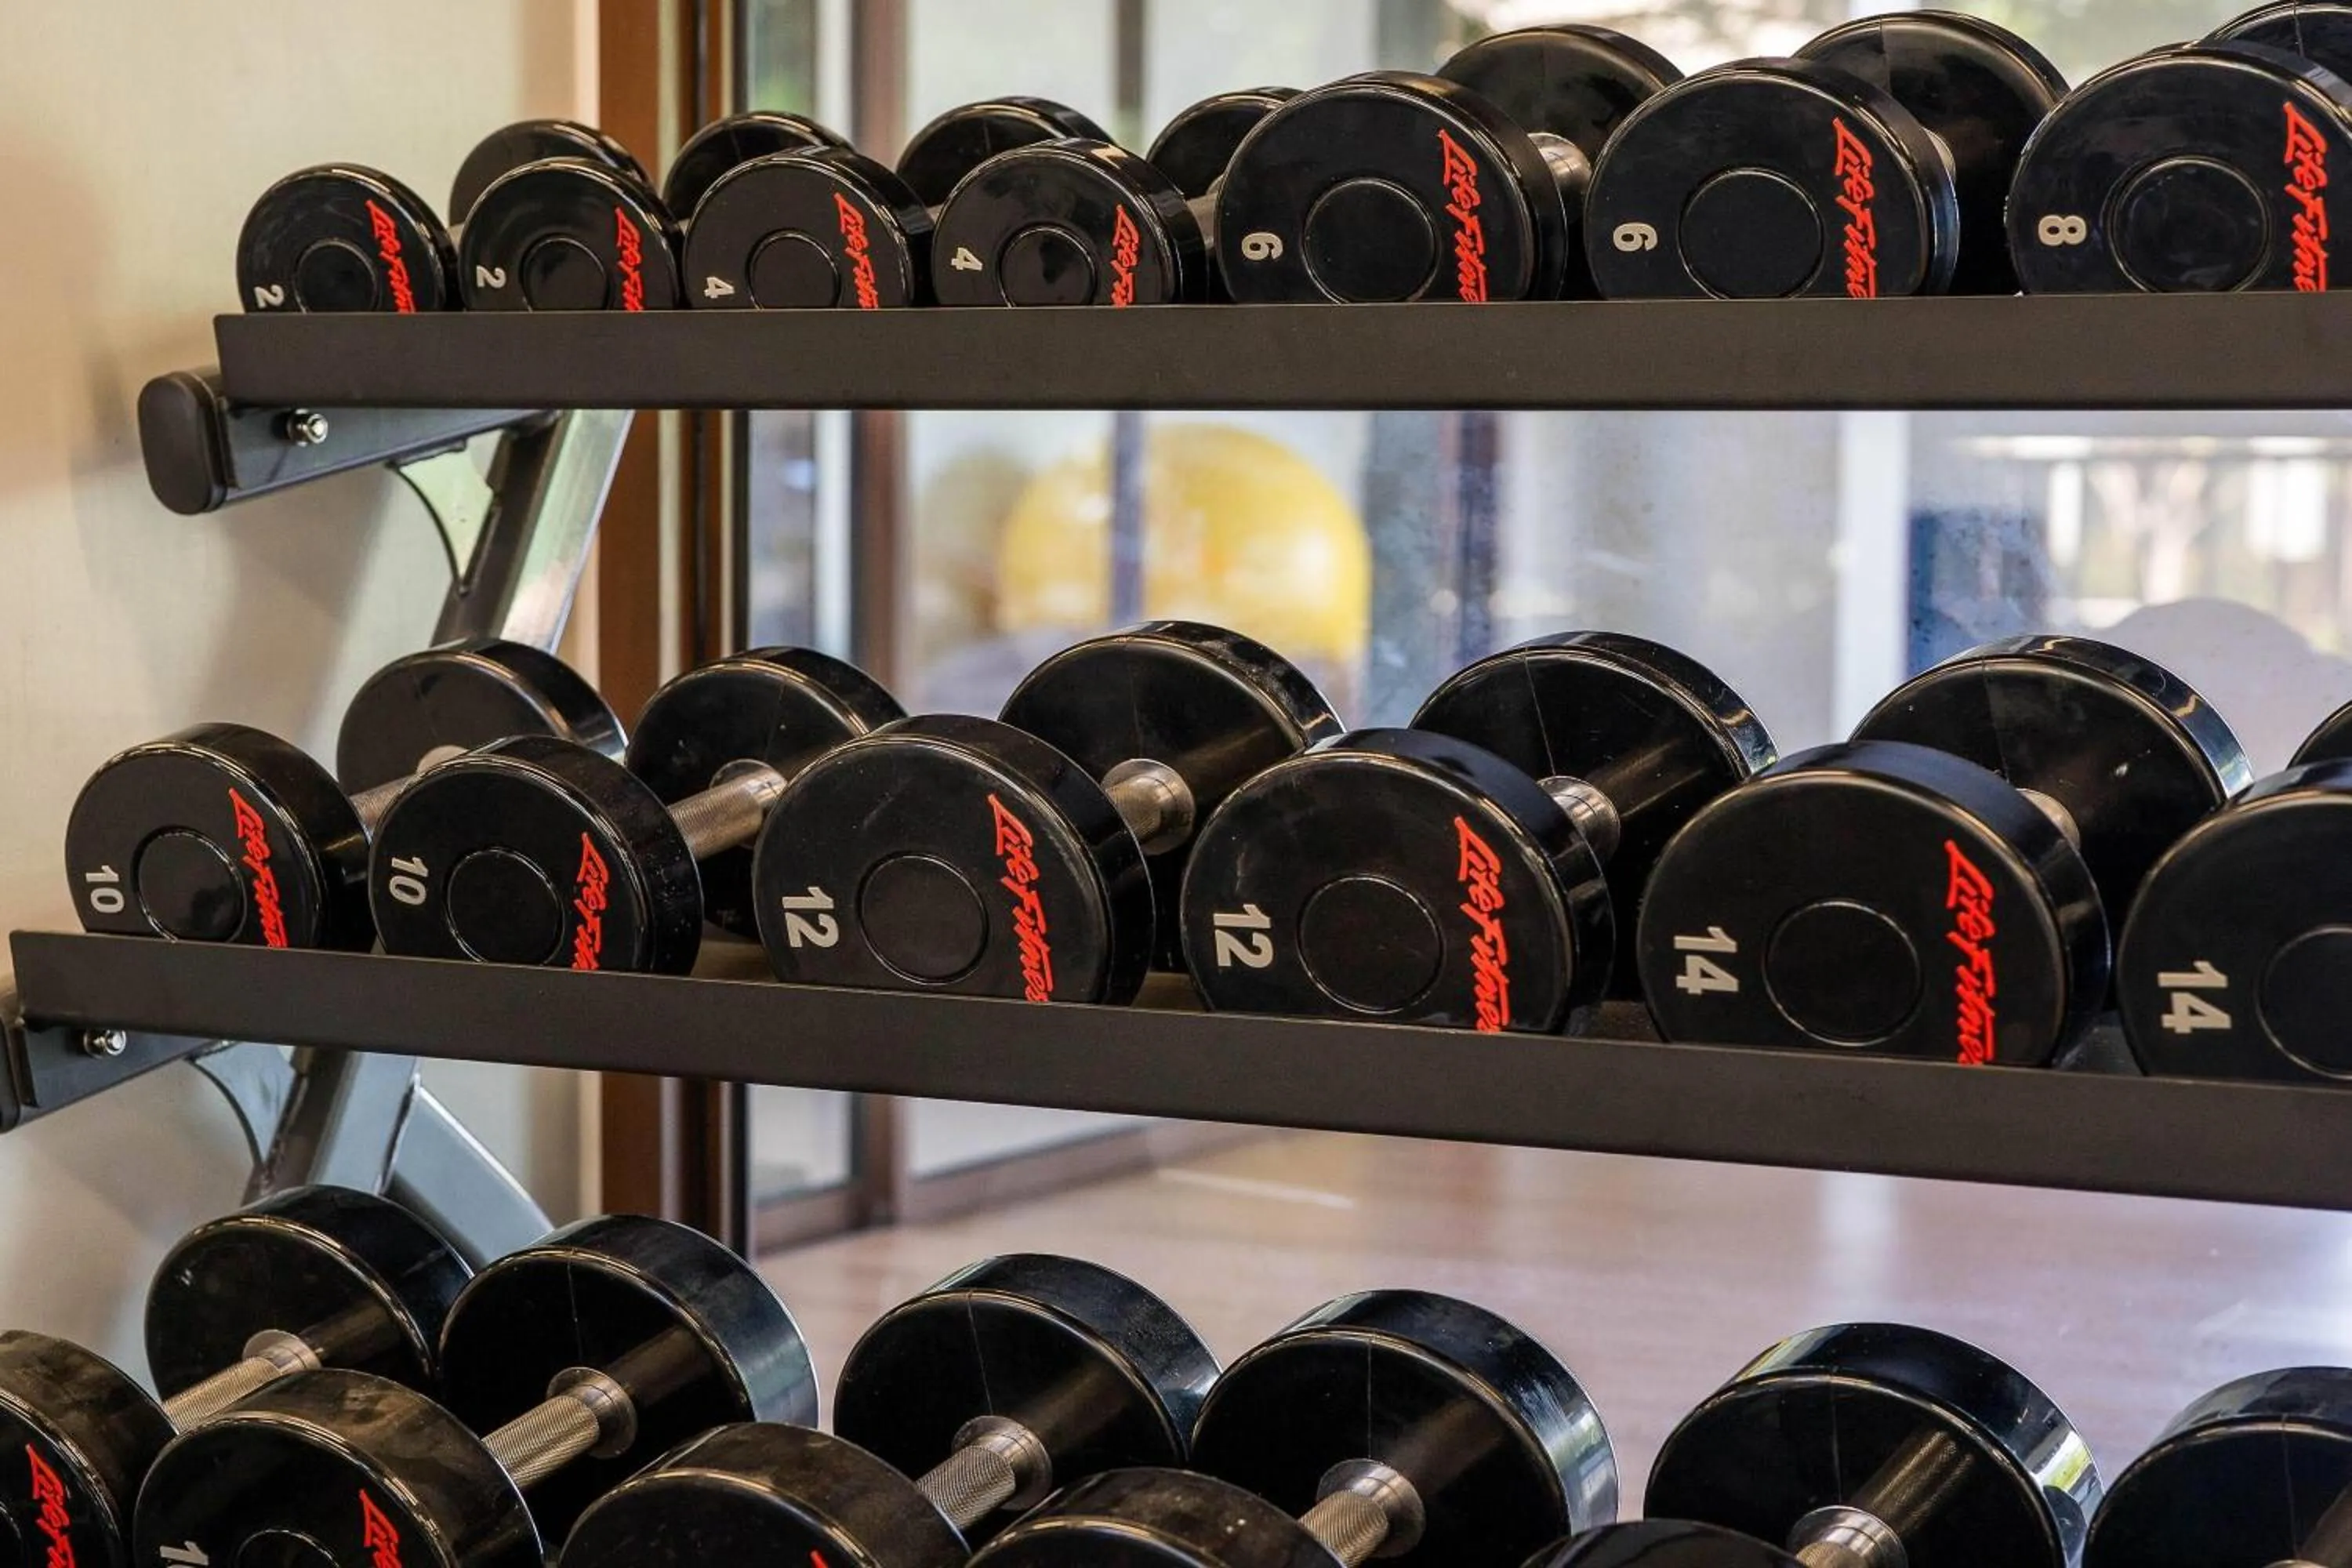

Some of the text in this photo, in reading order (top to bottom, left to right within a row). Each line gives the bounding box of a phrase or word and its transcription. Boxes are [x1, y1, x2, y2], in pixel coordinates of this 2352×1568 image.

[1613, 223, 1657, 251] 6
[2038, 215, 2086, 245] 8
[951, 248, 982, 270] 4
[1242, 233, 1283, 260] 6
[477, 266, 506, 288] 2
[704, 277, 735, 298] 4
[255, 285, 284, 307] 2
[86, 866, 124, 913] 10
[390, 857, 427, 904] 10
[782, 887, 838, 947] 12
[1214, 904, 1272, 967] 12
[1675, 927, 1737, 993] 14
[2158, 961, 2230, 1033] 14
[160, 1541, 208, 1568] 1
